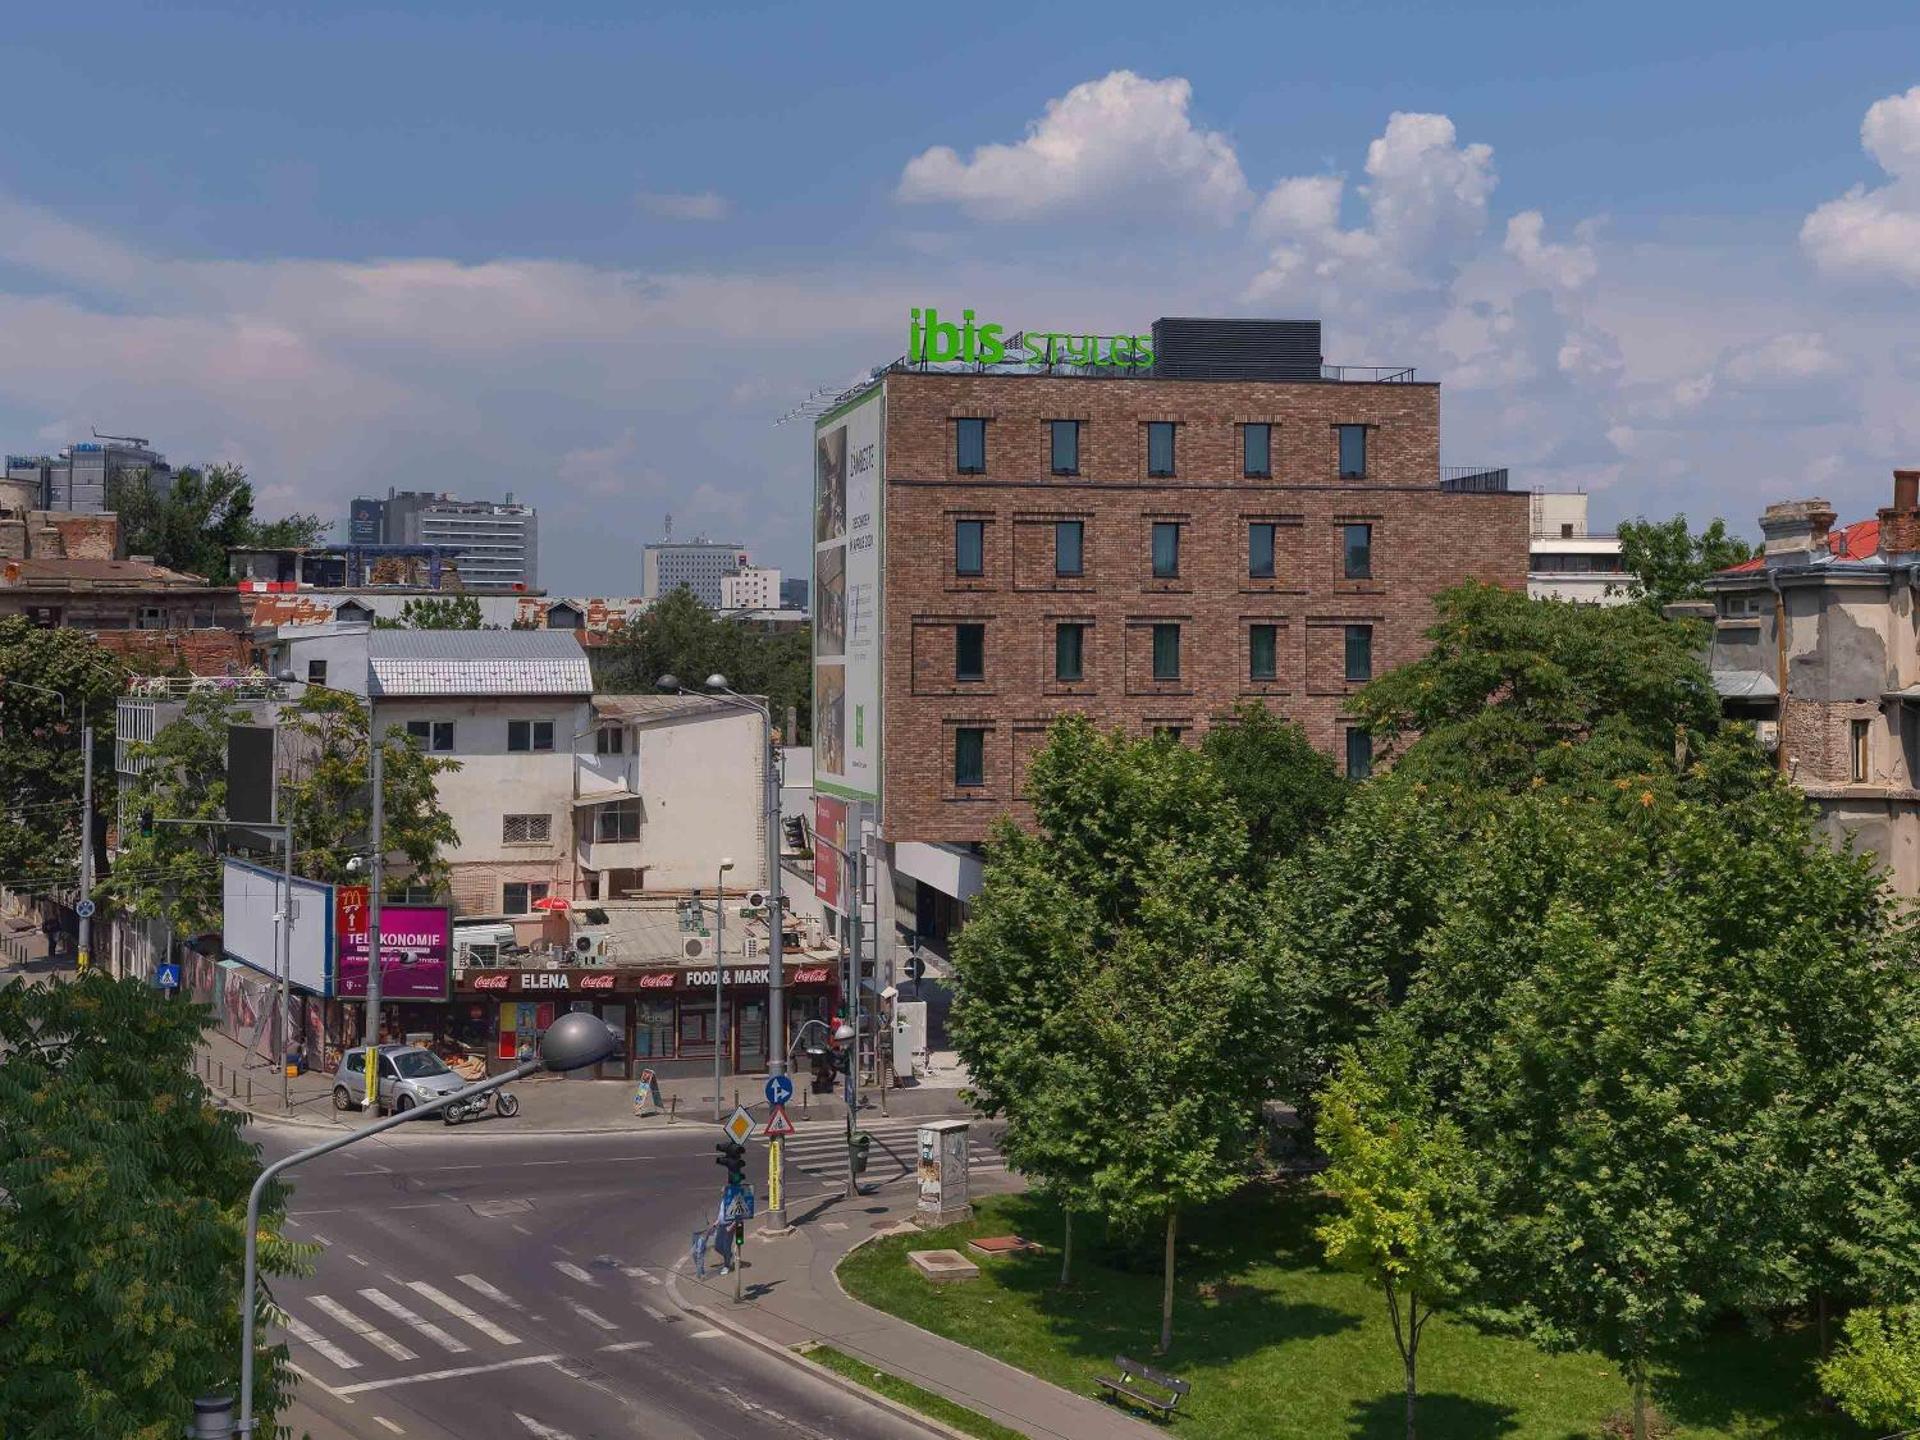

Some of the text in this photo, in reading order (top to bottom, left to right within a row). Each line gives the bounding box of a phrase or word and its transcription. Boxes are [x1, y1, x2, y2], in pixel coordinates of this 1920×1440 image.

[910, 308, 1004, 363] ibis
[347, 932, 440, 946] TELKONOMIE
[521, 973, 569, 989] ELENA
[686, 969, 784, 986] FOOD & MARK
